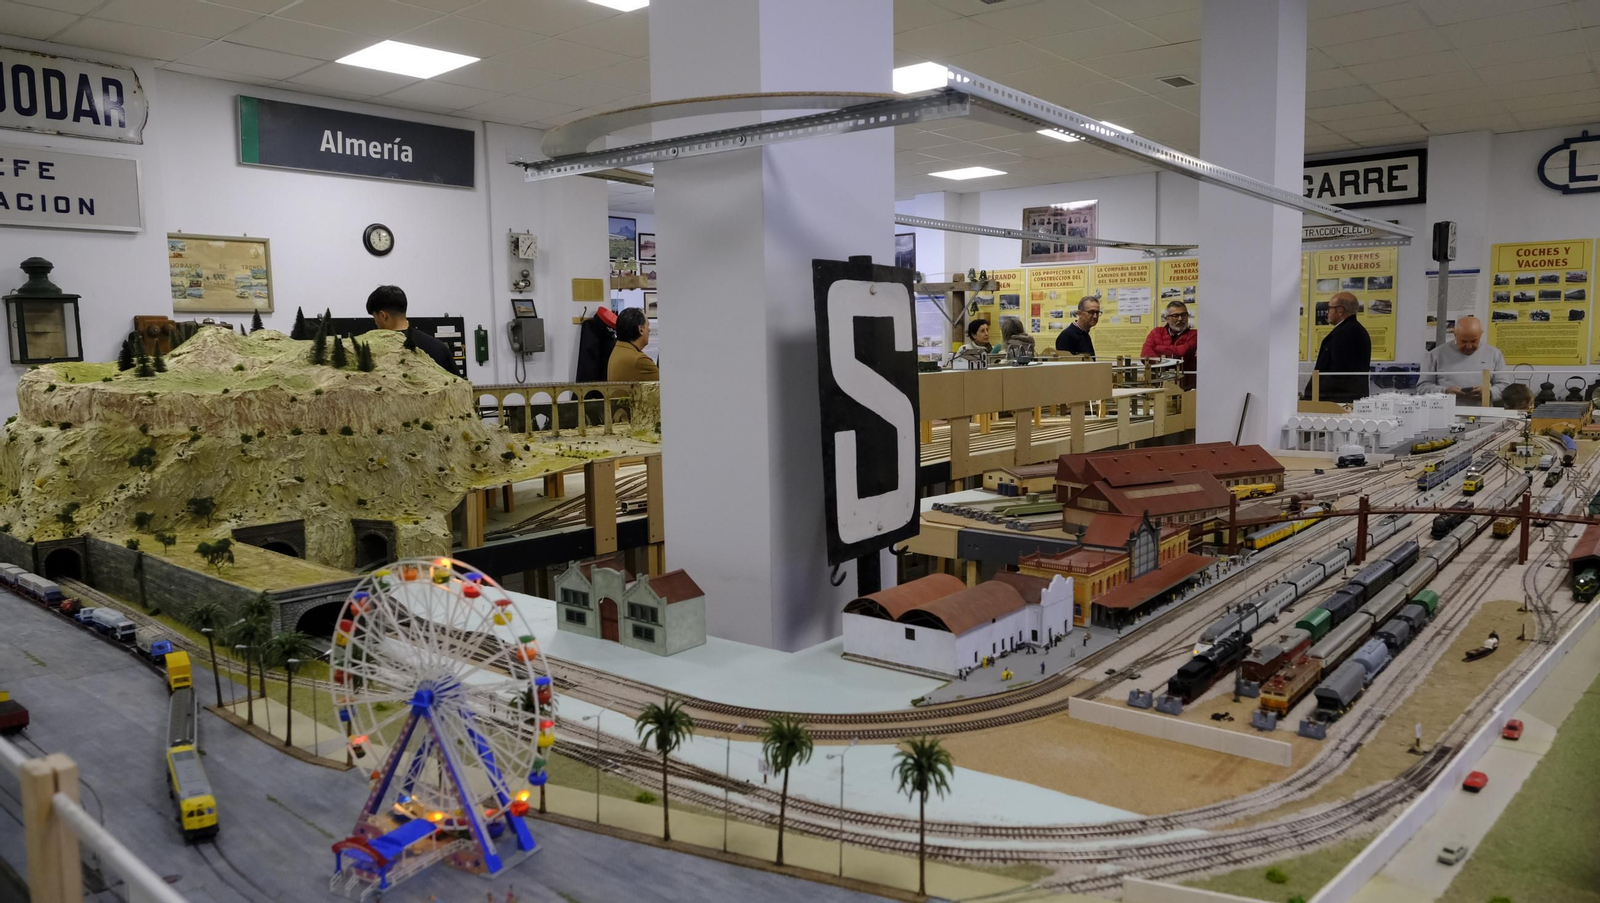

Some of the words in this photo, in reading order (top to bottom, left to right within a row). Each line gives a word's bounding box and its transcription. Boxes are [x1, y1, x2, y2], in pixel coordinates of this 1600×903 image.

[320, 130, 413, 162] Almería
[0, 157, 55, 180] FE
[1348, 252, 1380, 261] TRENES
[1516, 247, 1560, 257] COCHES
[1564, 246, 1571, 255] Y
[1342, 261, 1381, 270] VIAJEROS
[1517, 258, 1568, 268] VAGONES
[827, 279, 915, 544] S
